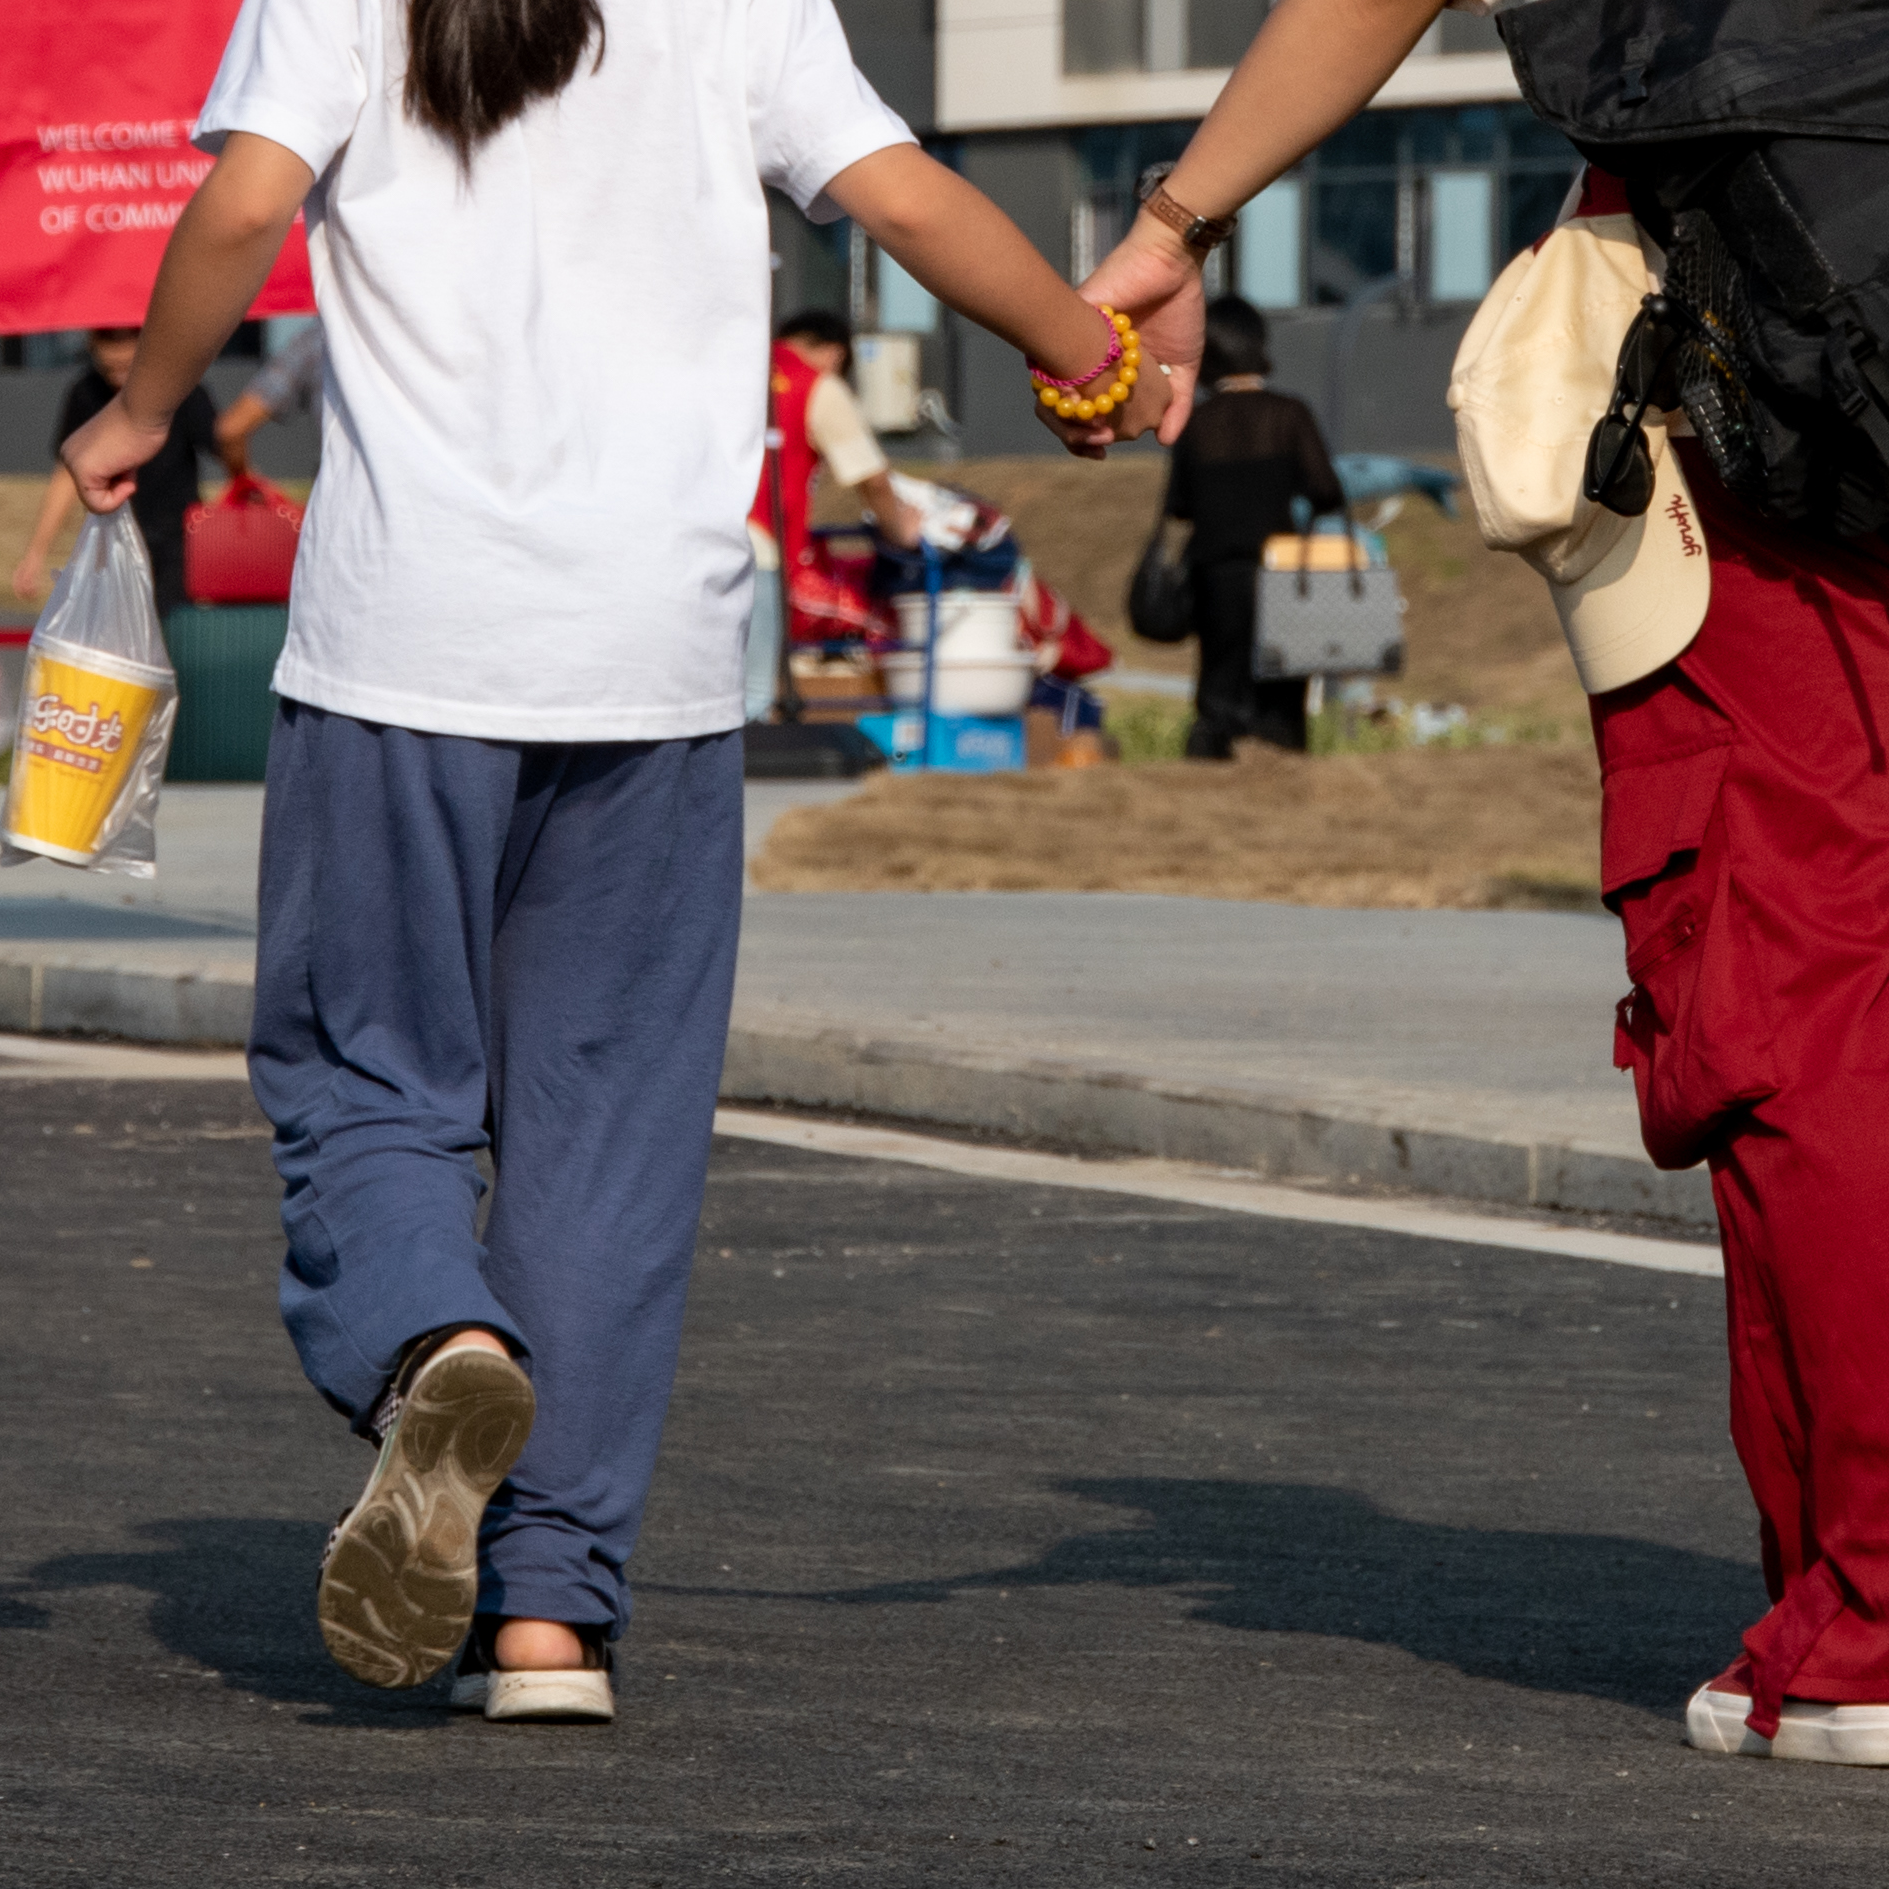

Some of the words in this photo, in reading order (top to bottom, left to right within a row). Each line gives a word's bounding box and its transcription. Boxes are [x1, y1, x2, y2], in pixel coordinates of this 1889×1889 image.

[37, 120, 179, 153] WELCOME
[37, 163, 152, 194] WUHAN
[39, 205, 79, 235] OF
[25, 694, 123, 752] 乐时光
